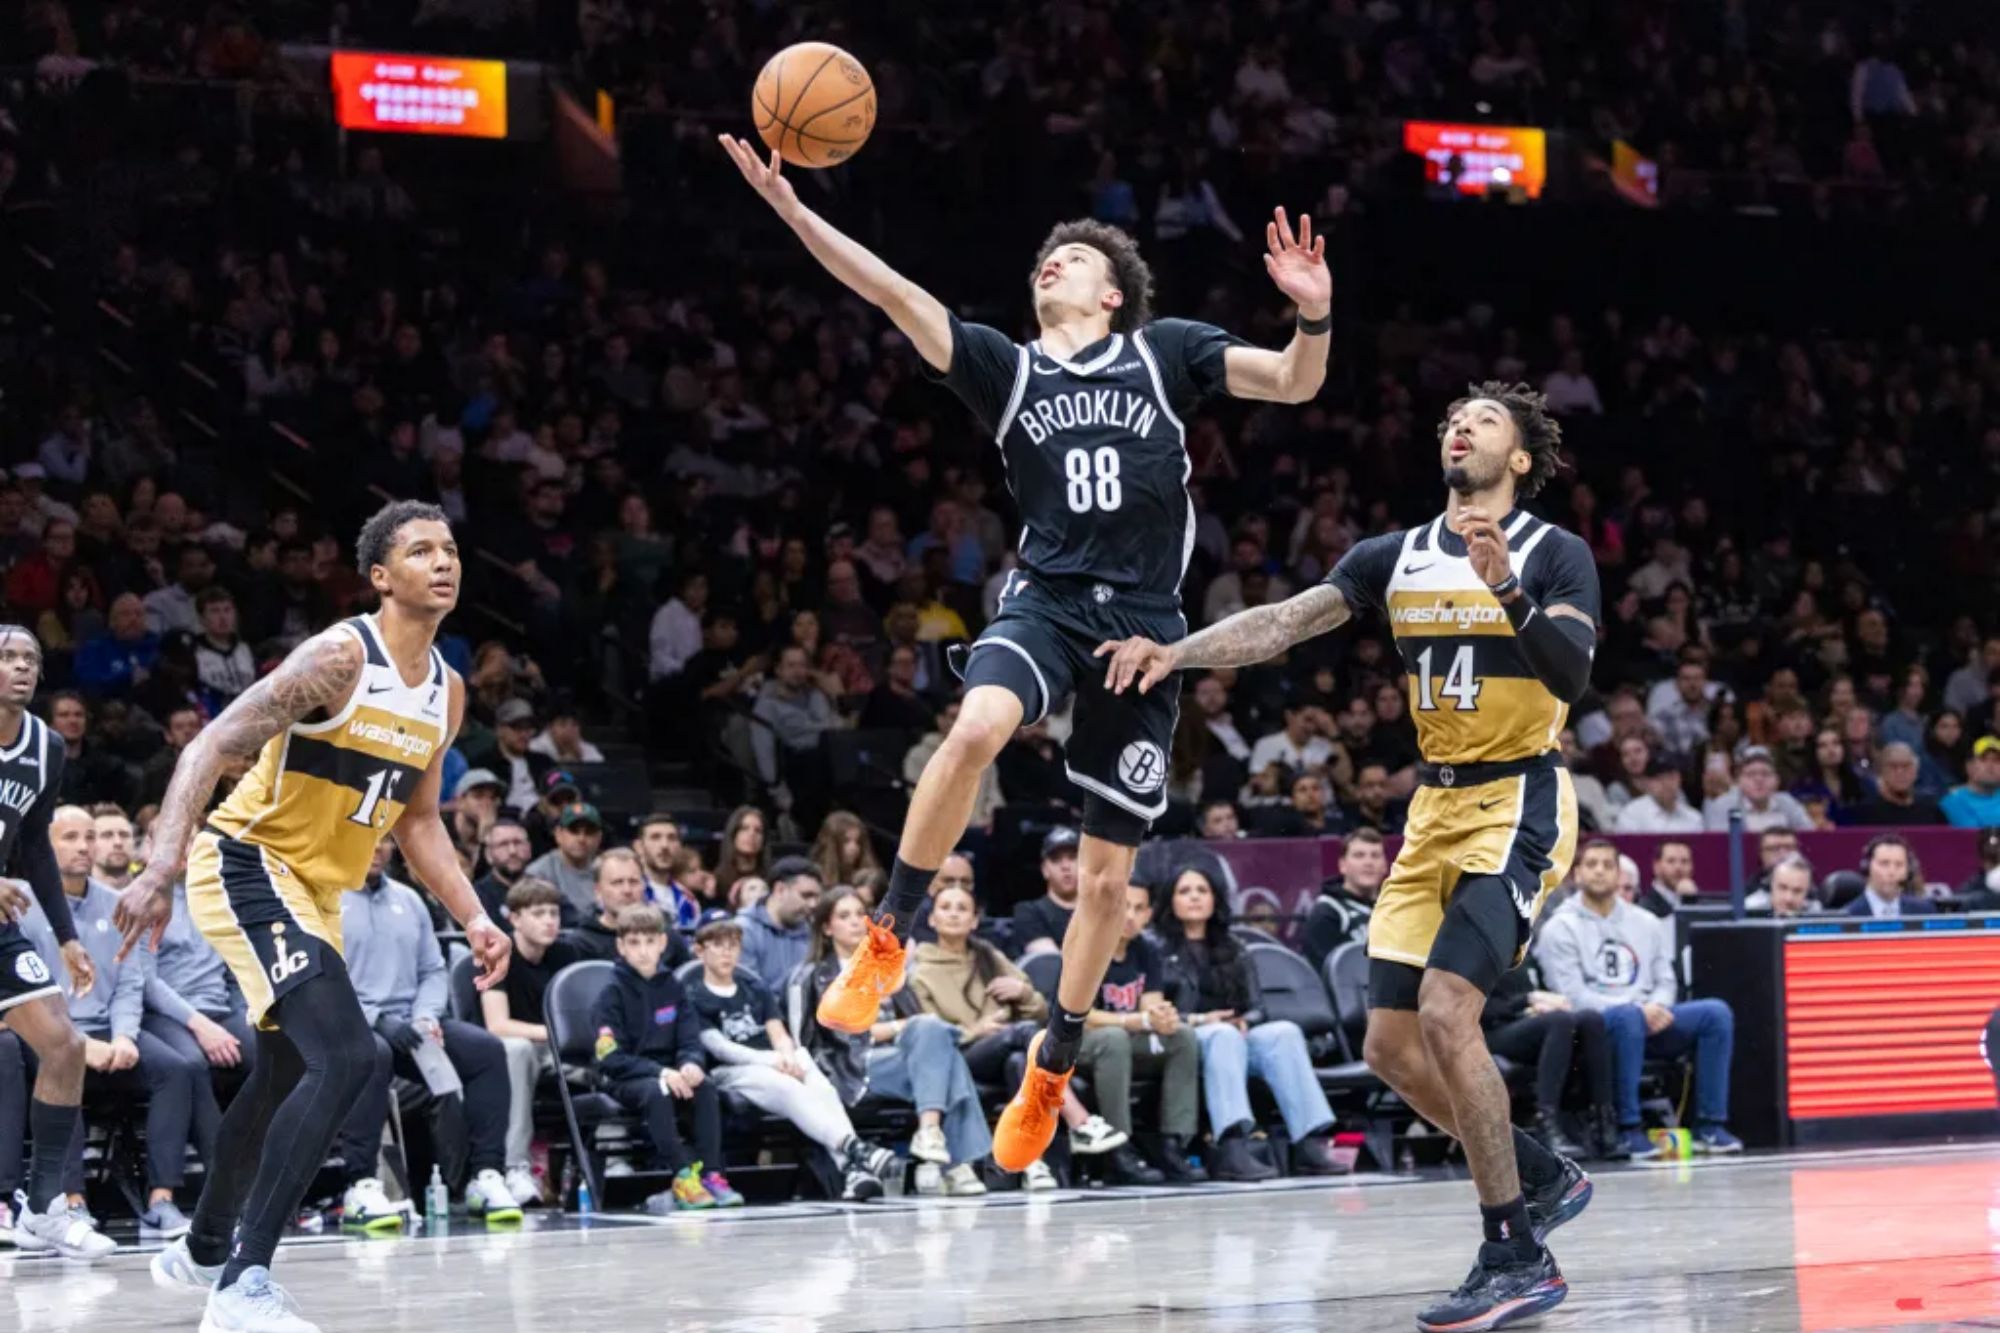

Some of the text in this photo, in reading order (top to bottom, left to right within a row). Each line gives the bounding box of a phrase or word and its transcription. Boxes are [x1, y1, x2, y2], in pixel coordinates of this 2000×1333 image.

[1018, 389, 1157, 445] BROOKLYN
[1065, 446, 1122, 513] 88
[1393, 599, 1508, 629] washington
[1416, 645, 1483, 711] 14
[349, 719, 433, 757] washington
[1128, 749, 1157, 784] B
